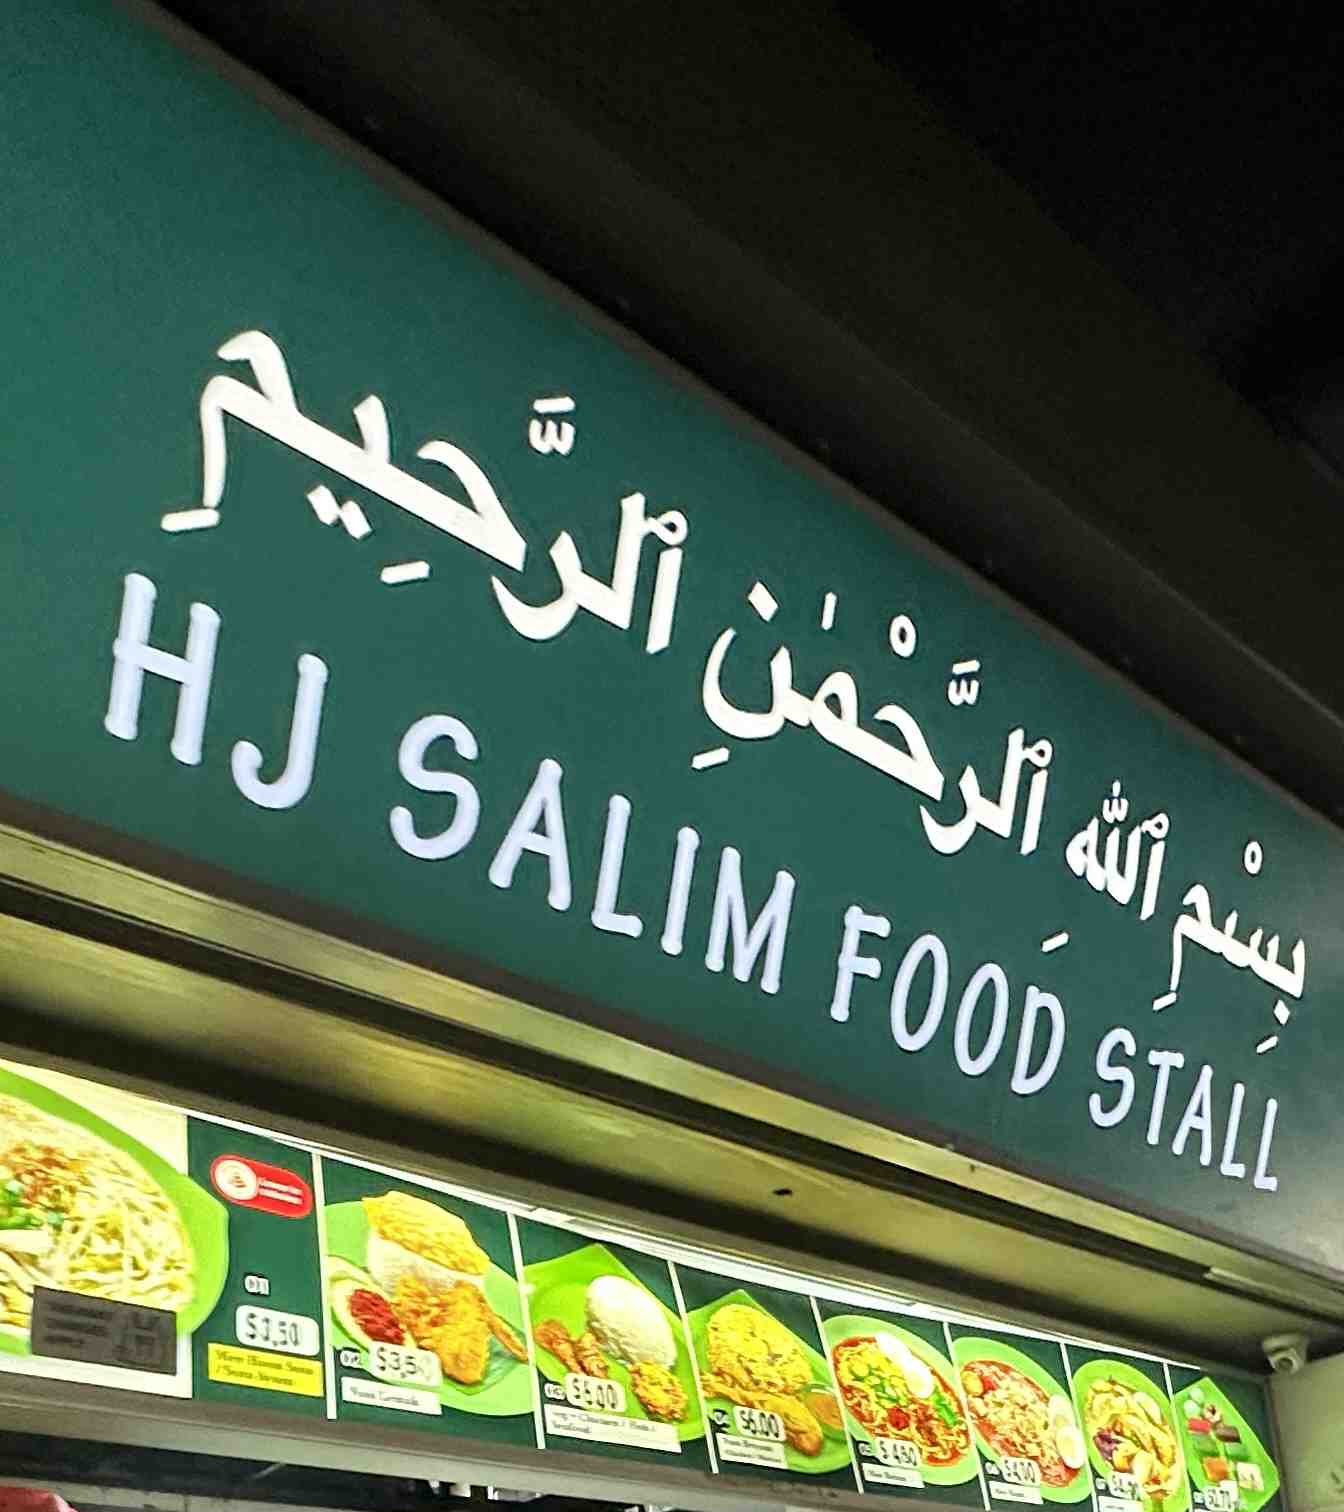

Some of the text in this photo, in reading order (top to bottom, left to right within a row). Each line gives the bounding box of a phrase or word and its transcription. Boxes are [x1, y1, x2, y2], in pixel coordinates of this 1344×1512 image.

[104, 573, 1280, 1193] HJ SALIM FOOD STALL
